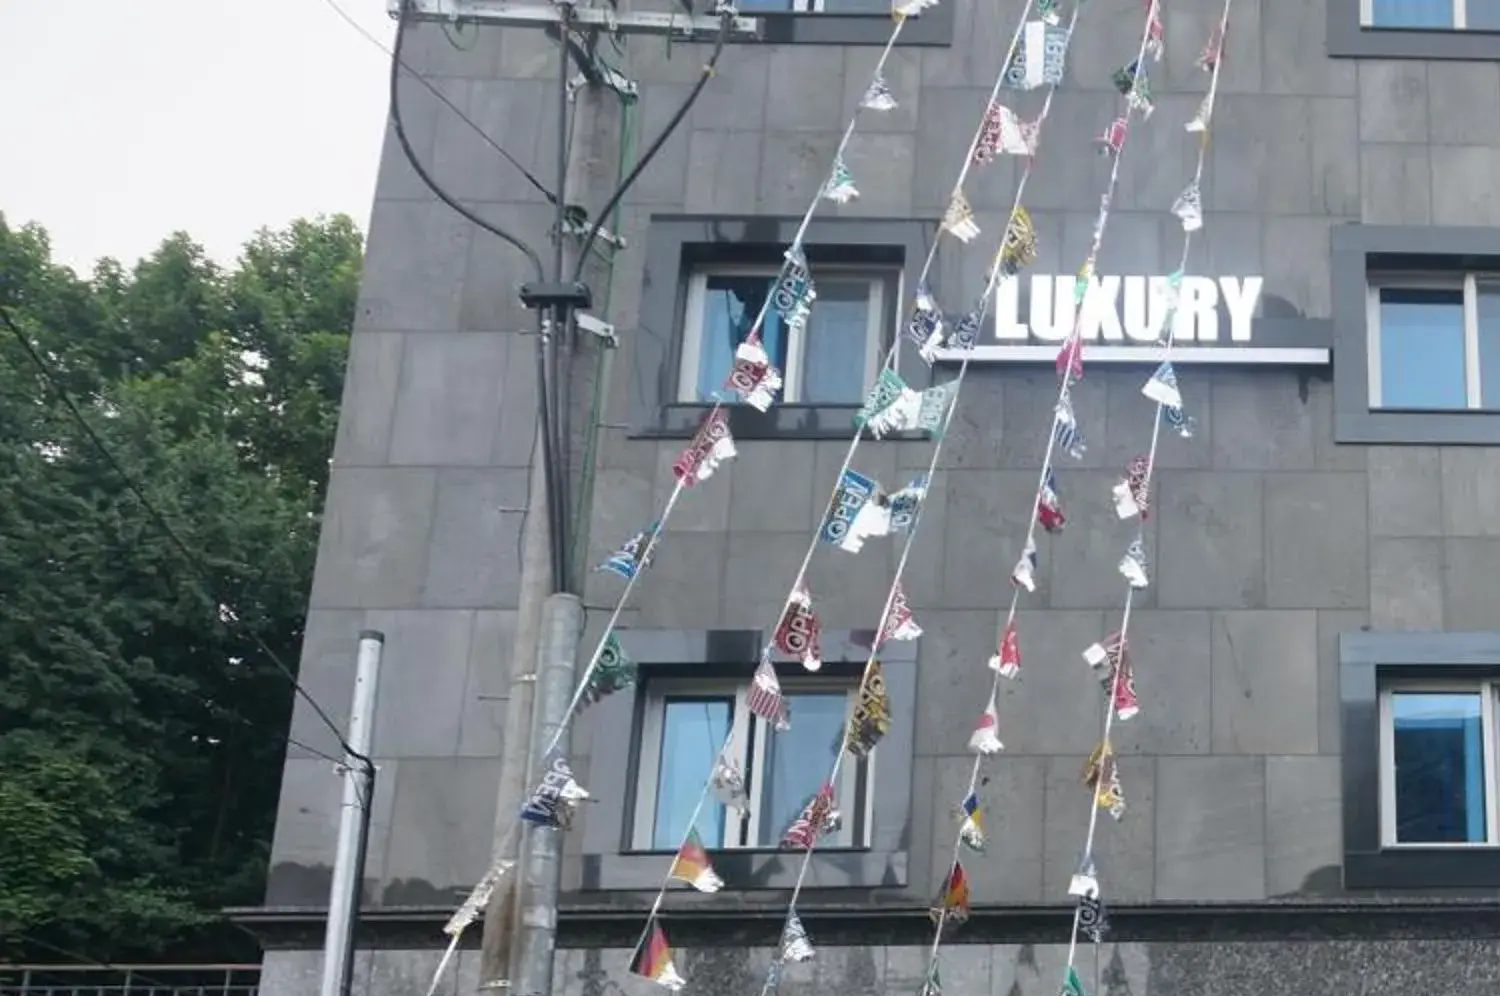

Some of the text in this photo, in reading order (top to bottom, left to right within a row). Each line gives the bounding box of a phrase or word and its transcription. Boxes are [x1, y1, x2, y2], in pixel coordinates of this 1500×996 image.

[774, 263, 807, 310] OPE
[996, 275, 1262, 341] LUXURY
[827, 474, 870, 541] OPEN
[784, 606, 814, 652] OPE
